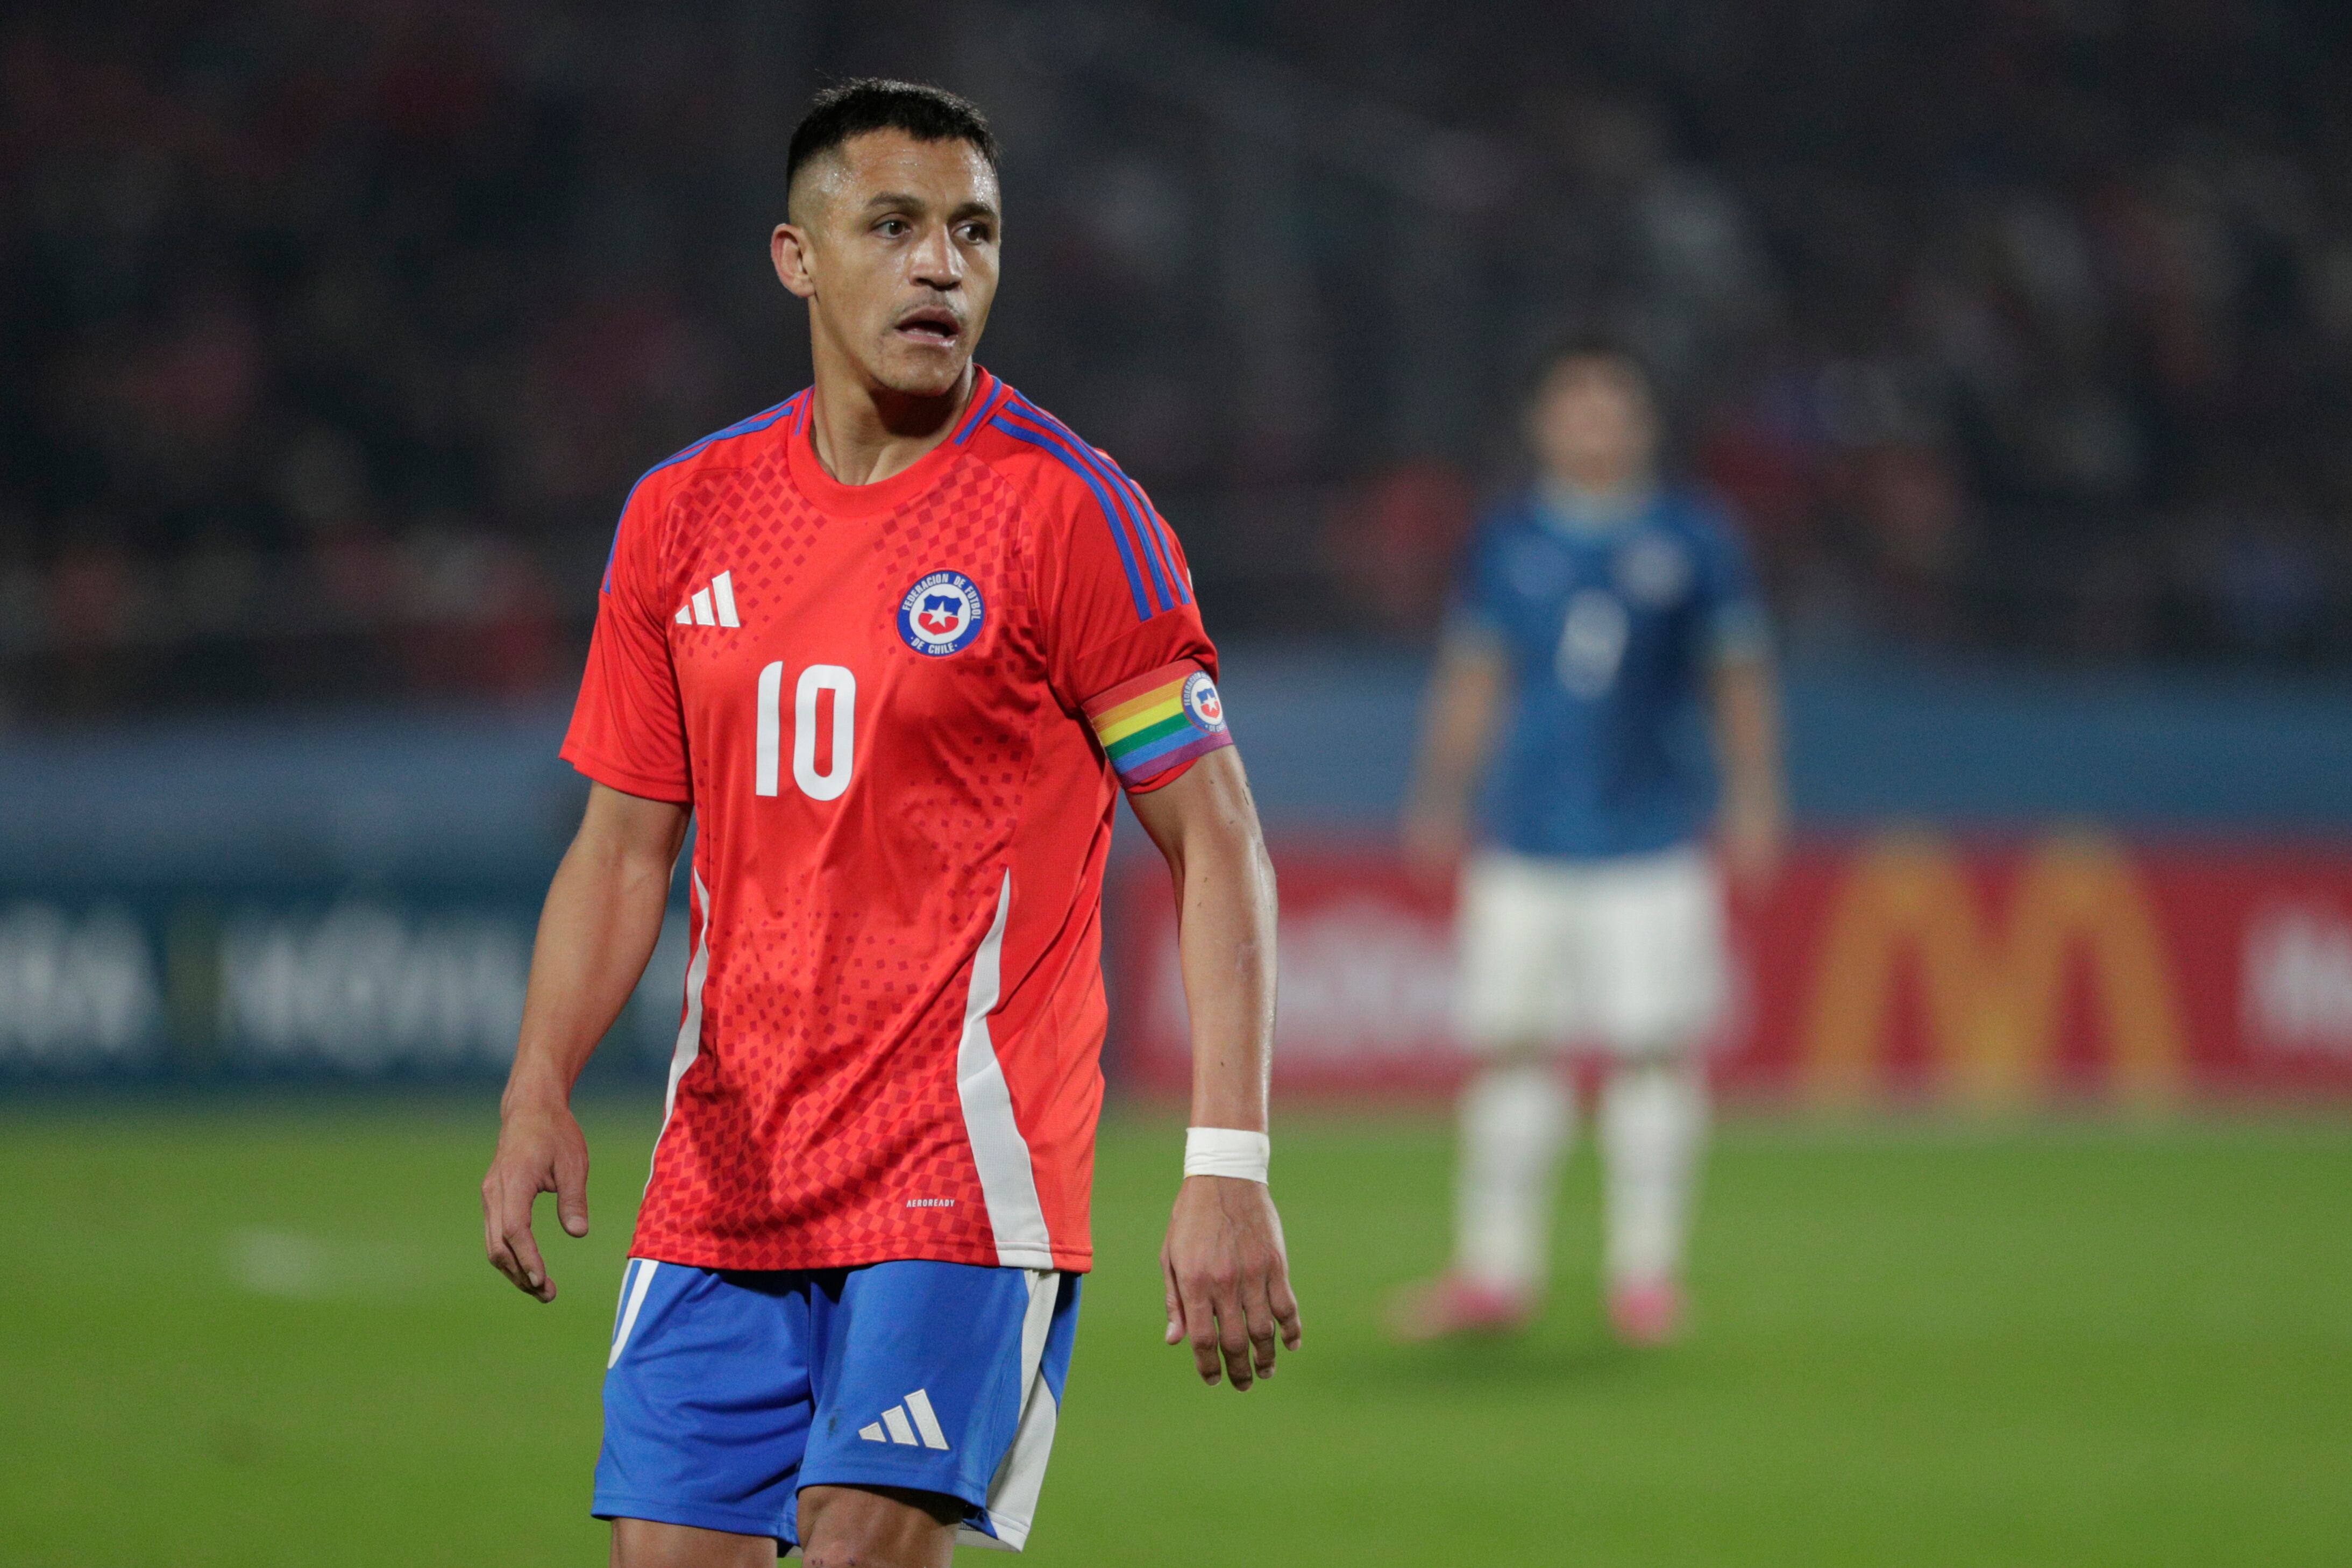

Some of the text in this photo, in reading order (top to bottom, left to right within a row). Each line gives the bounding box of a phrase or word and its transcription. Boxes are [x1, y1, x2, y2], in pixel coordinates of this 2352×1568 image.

[902, 573, 982, 621] FEDERACION DE FUTBOL
[755, 660, 856, 801] 10
[906, 1199, 955, 1208] AEROREADY
